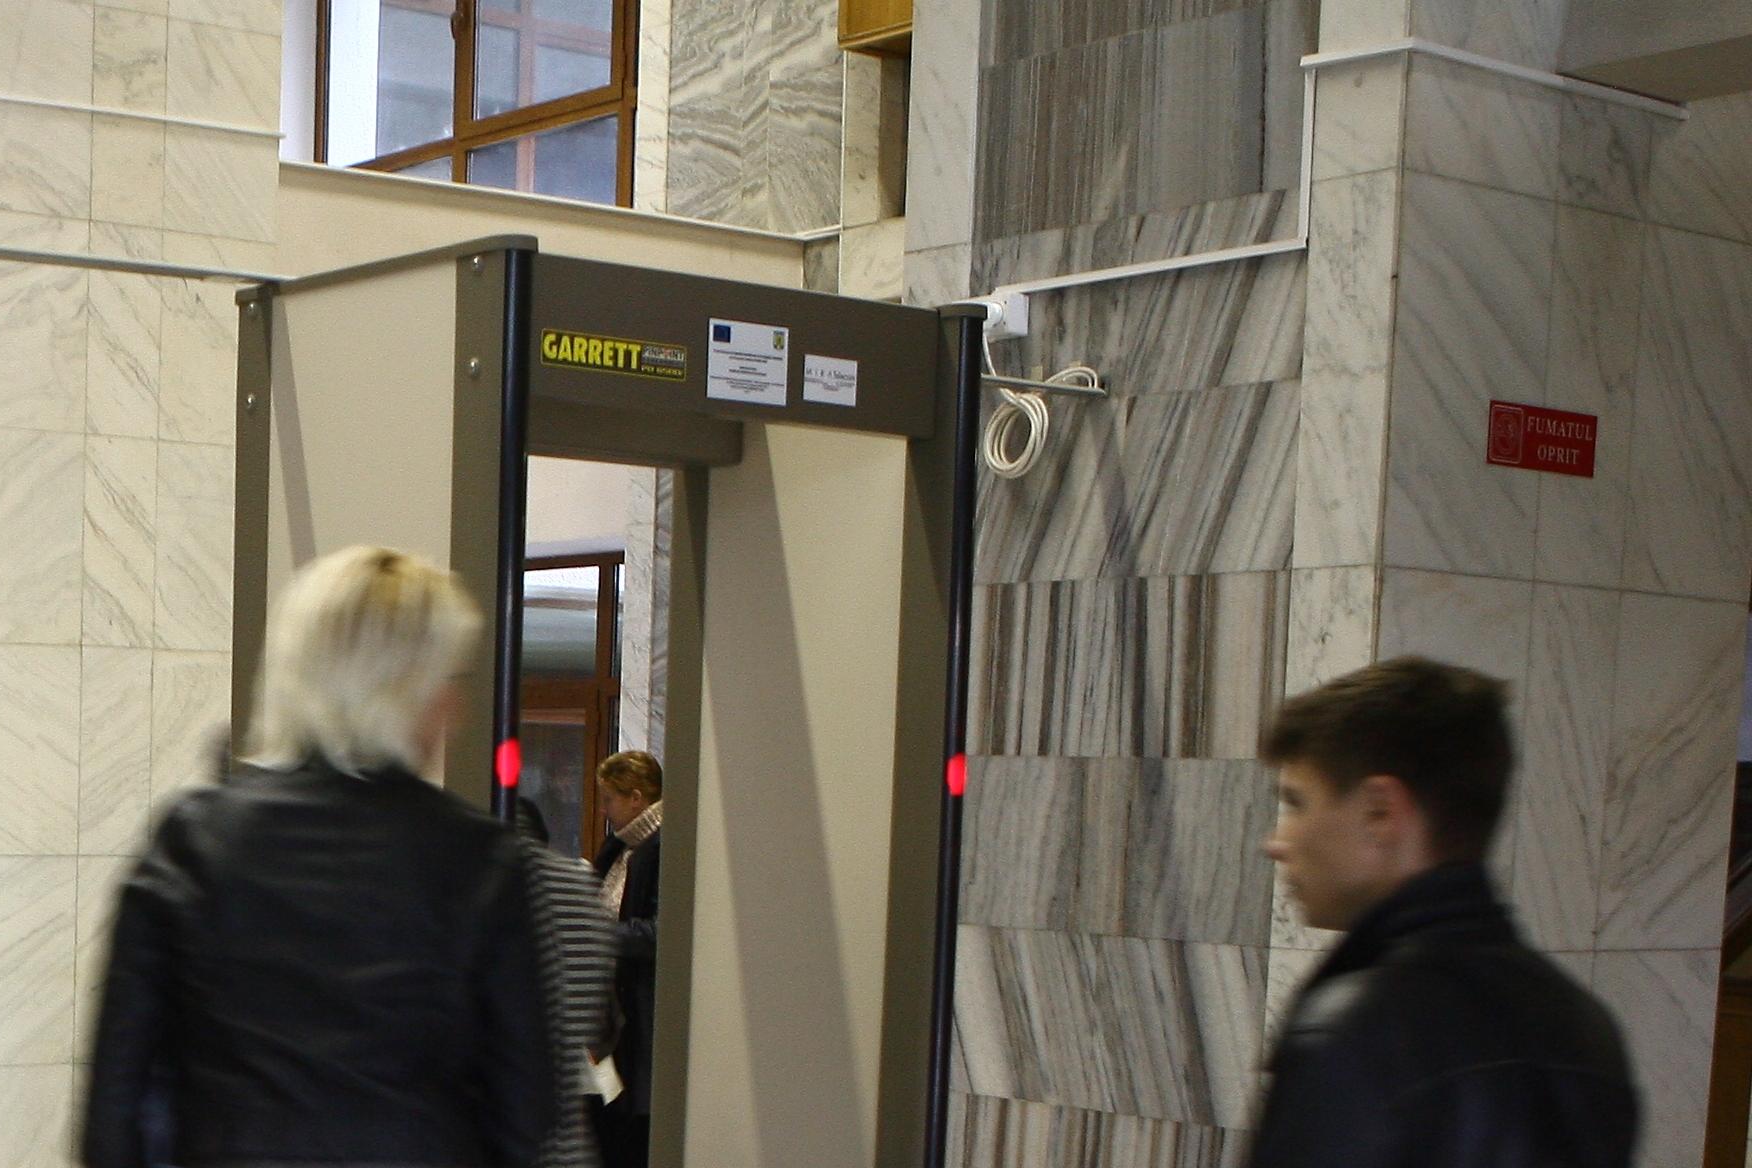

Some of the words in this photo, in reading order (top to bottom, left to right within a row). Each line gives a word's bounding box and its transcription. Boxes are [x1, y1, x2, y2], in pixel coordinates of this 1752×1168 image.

[543, 333, 642, 370] GARRETT
[1526, 416, 1593, 441] FUMATUL
[1537, 445, 1580, 465] OPRIT
